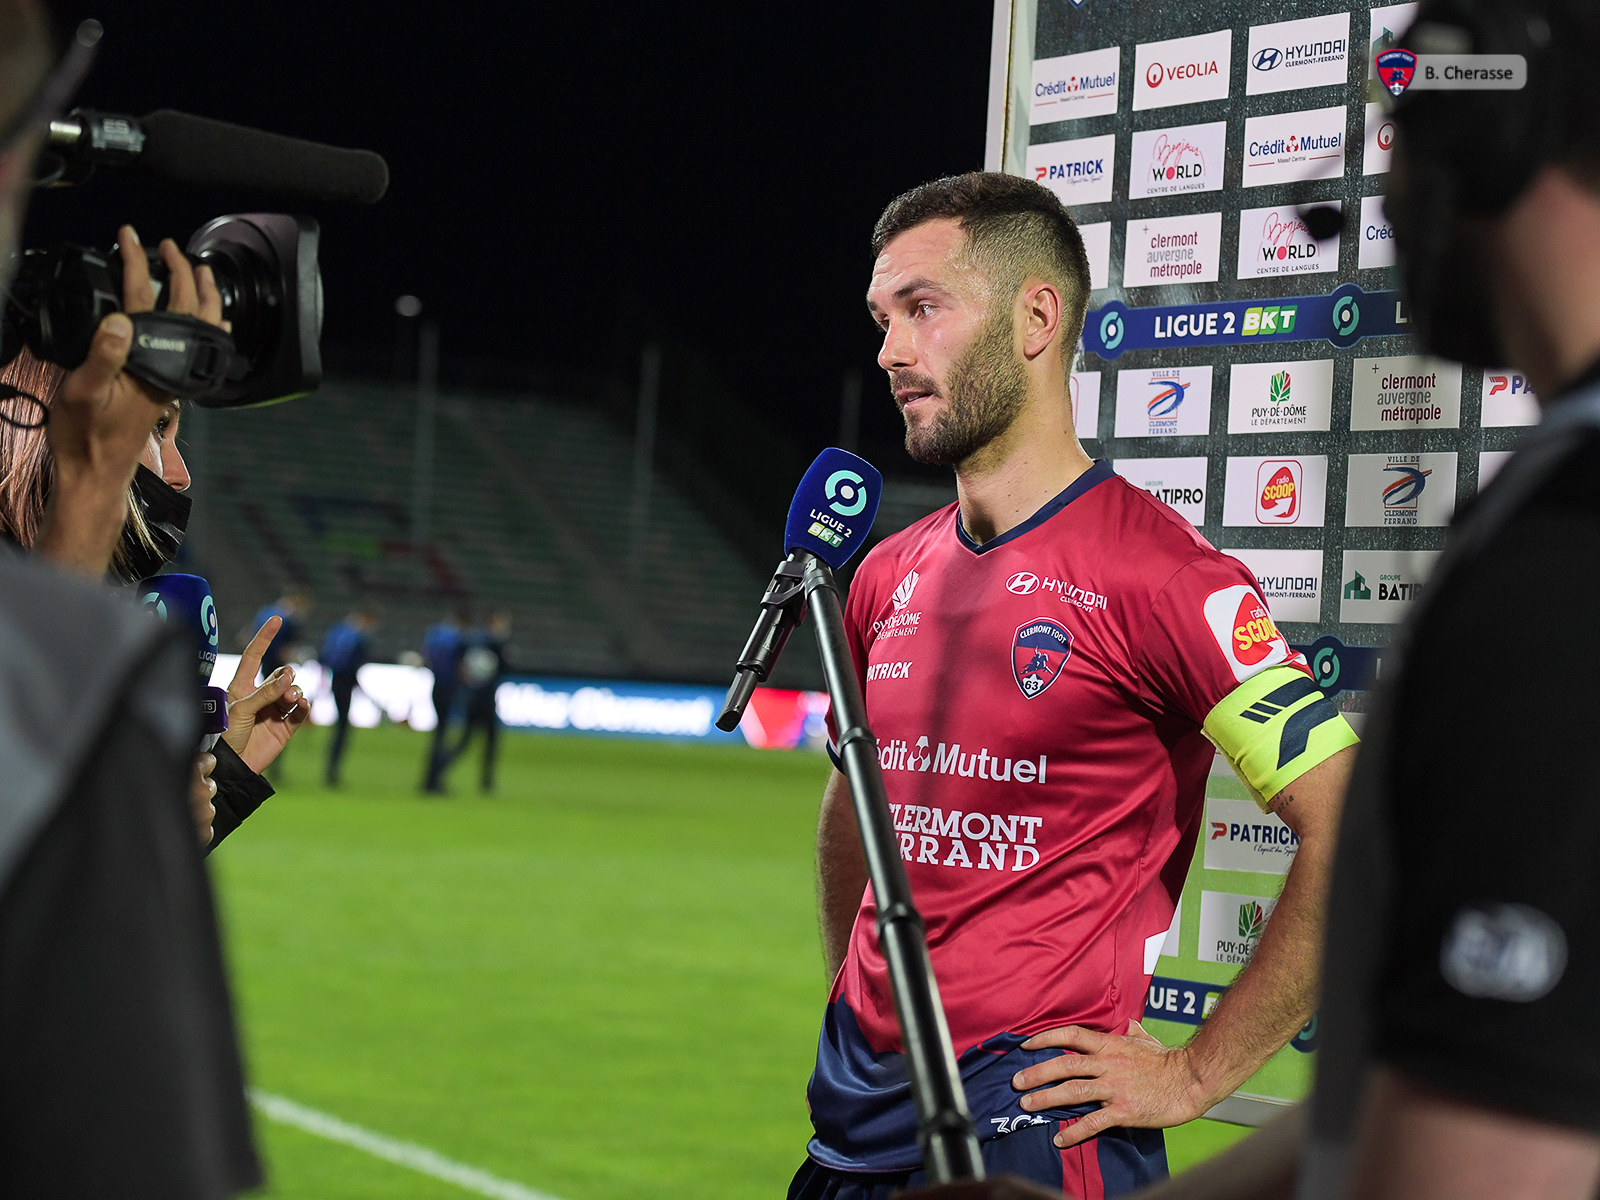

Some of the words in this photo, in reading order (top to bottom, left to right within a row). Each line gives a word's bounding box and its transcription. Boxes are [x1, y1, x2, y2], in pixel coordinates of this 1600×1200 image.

[1285, 39, 1346, 60] HYUNDAI
[1285, 54, 1345, 68] CLERMONT-FERRAND
[1166, 60, 1219, 82] VEOLIA
[1035, 80, 1067, 97] Crédit
[1079, 72, 1116, 91] Mutuel
[1249, 139, 1285, 157] Crédit
[1300, 132, 1342, 151] Mutuel
[1049, 159, 1104, 180] PATRICK
[1152, 163, 1202, 181] WORLD
[1147, 186, 1168, 194] CENTRE
[1179, 182, 1206, 191] LANGUES
[1150, 231, 1198, 249] clermont
[1147, 248, 1194, 264] auvergne
[1262, 243, 1317, 261] WORLD
[1150, 260, 1202, 279] métropole
[1256, 266, 1280, 274] CENTRE
[1281, 265, 1289, 273] DE
[1291, 263, 1320, 271] LANGUES
[1154, 312, 1219, 339] LIGUE
[1222, 311, 1236, 335] 2
[1243, 309, 1296, 331] BKT
[1381, 372, 1437, 389] clermont
[1377, 390, 1432, 406] auvergne
[1251, 418, 1258, 426] LE
[1259, 416, 1307, 426] DÉPARTEMENT
[1381, 403, 1442, 424] métropole
[1145, 488, 1204, 505] ATIPRO
[1264, 482, 1295, 501] SCOOP
[1384, 509, 1418, 517] CLERMONT
[1384, 517, 1418, 525] FERRAND
[809, 508, 846, 533] LIGUE
[843, 528, 853, 538] 2
[1257, 577, 1318, 591] HYUNDAI
[1042, 576, 1108, 611] HYUNDAI
[1018, 625, 1052, 640] CLERMONT
[1051, 627, 1068, 644] FOOT
[1024, 679, 1040, 692] 63
[932, 742, 1047, 784] Mutuel
[888, 802, 1043, 844] LERMONT
[895, 832, 1041, 872] RRAND
[1216, 953, 1223, 962] LE
[1182, 990, 1197, 1015] 2
